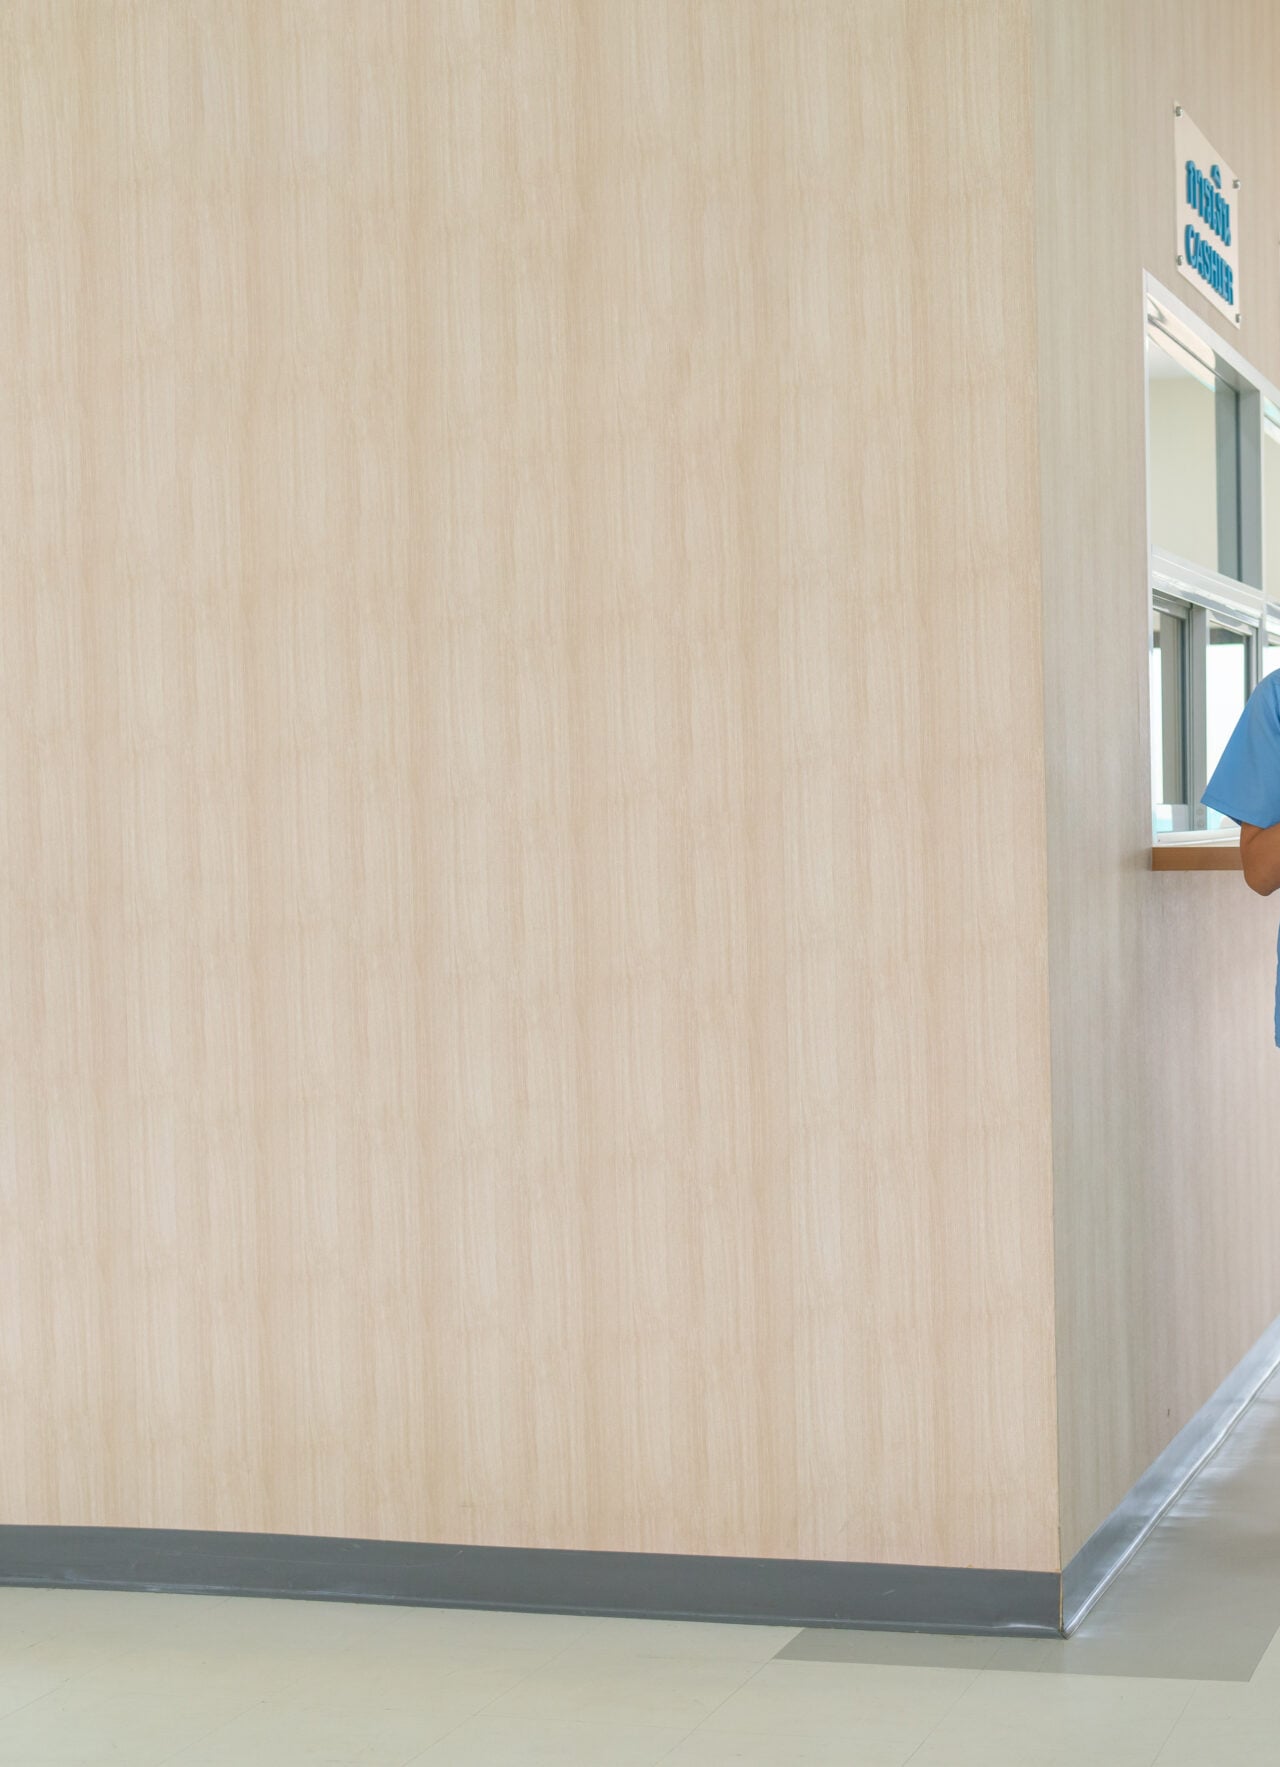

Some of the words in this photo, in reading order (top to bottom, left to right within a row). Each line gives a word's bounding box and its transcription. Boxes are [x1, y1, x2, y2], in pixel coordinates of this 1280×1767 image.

[1185, 160, 1231, 247] การเงิน
[1184, 224, 1234, 306] CASHIER
